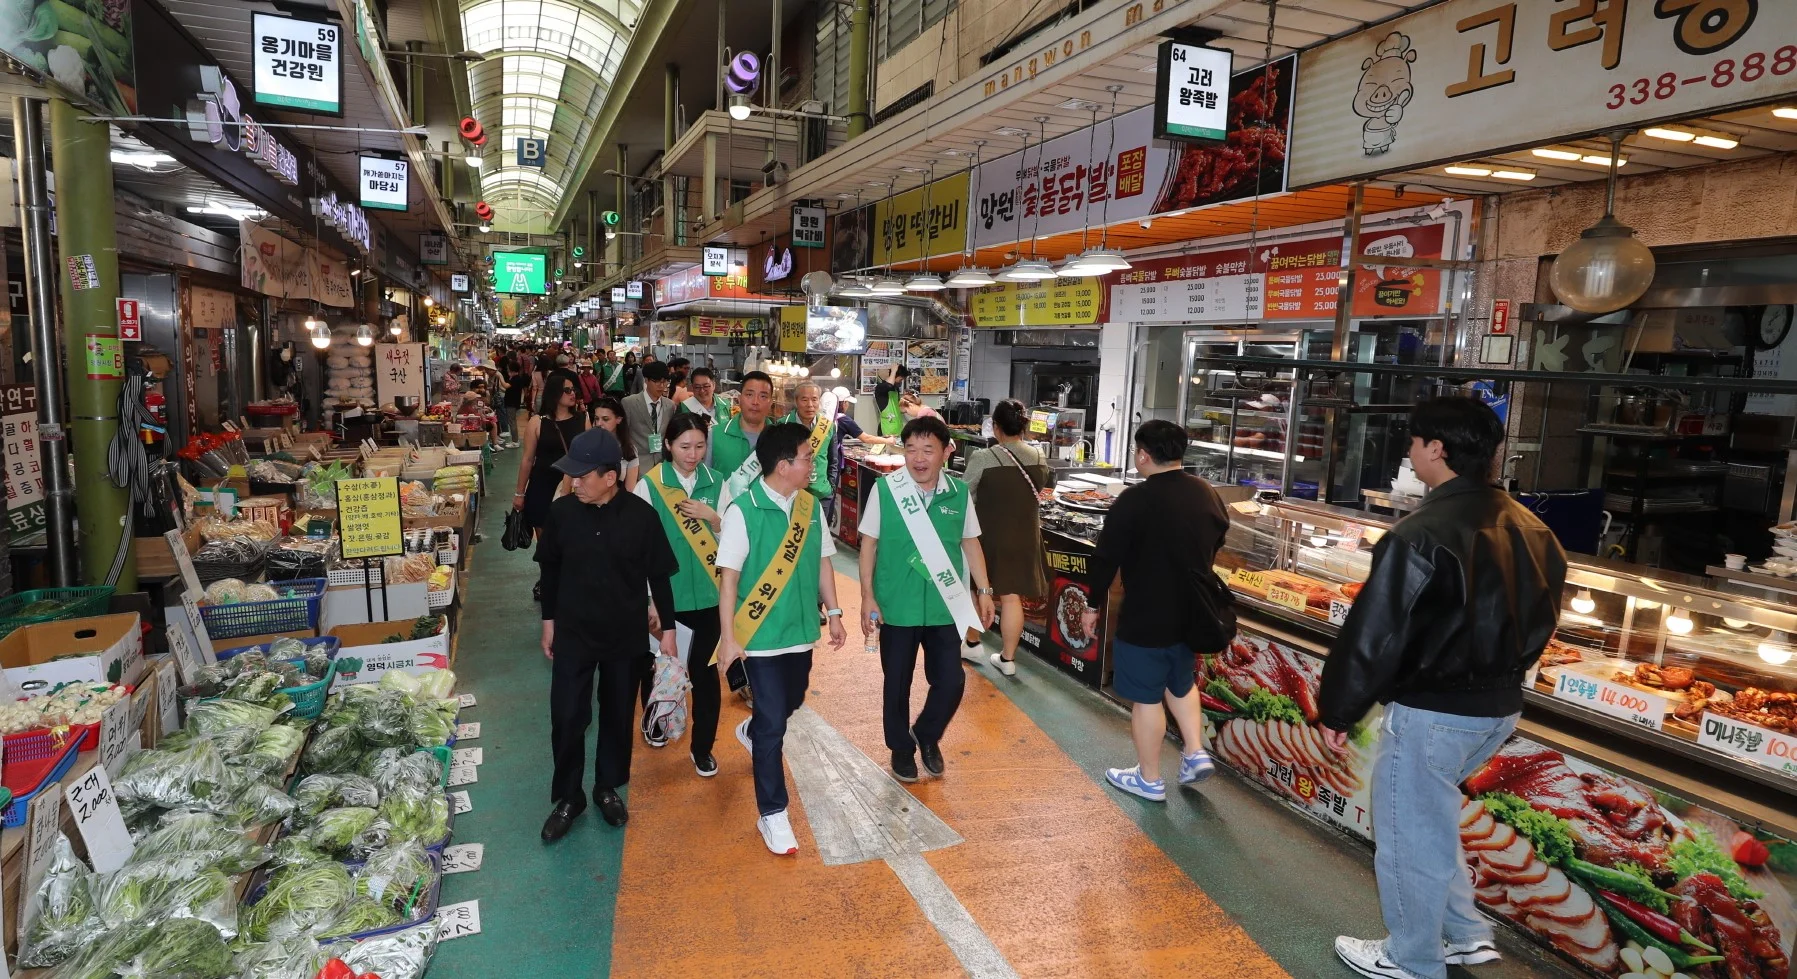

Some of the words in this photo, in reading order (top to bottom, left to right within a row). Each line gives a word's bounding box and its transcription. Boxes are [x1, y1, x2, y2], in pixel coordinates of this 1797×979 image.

[318, 28, 336, 42] 59
[262, 36, 332, 62] 옹기마을
[1172, 47, 1186, 63] 64
[272, 59, 323, 82] 건강원
[983, 30, 1091, 97] mangwon
[1187, 66, 1213, 87] 고려
[1179, 87, 1218, 110] 왕족발
[524, 140, 539, 159] B
[395, 163, 405, 171] 57
[1121, 151, 1144, 171] 포장
[369, 180, 398, 192] 마당쇠
[1120, 173, 1143, 194] 배달
[980, 189, 1015, 231] 망원
[1022, 162, 1115, 218] 숯불닭발
[800, 216, 819, 228] 망원
[911, 199, 959, 242] 떡갈비
[795, 229, 823, 241] 떡갈비
[1215, 261, 1246, 275] 숯불막창
[386, 349, 410, 366] 새우젓
[389, 368, 406, 384] 국산
[345, 504, 368, 514] 건강즙
[783, 521, 803, 563] 친절
[900, 495, 921, 515] 친
[936, 568, 957, 588] 절
[1052, 552, 1070, 570] 매운
[1071, 557, 1087, 574] 맛!!
[1238, 570, 1263, 588] 국내산
[747, 582, 778, 621] 위생
[1631, 713, 1656, 728] 국내산
[1705, 718, 1763, 752] 미니족발
[1266, 758, 1293, 787] 고려
[1298, 776, 1314, 797] 왕
[1318, 784, 1348, 817] 족발
